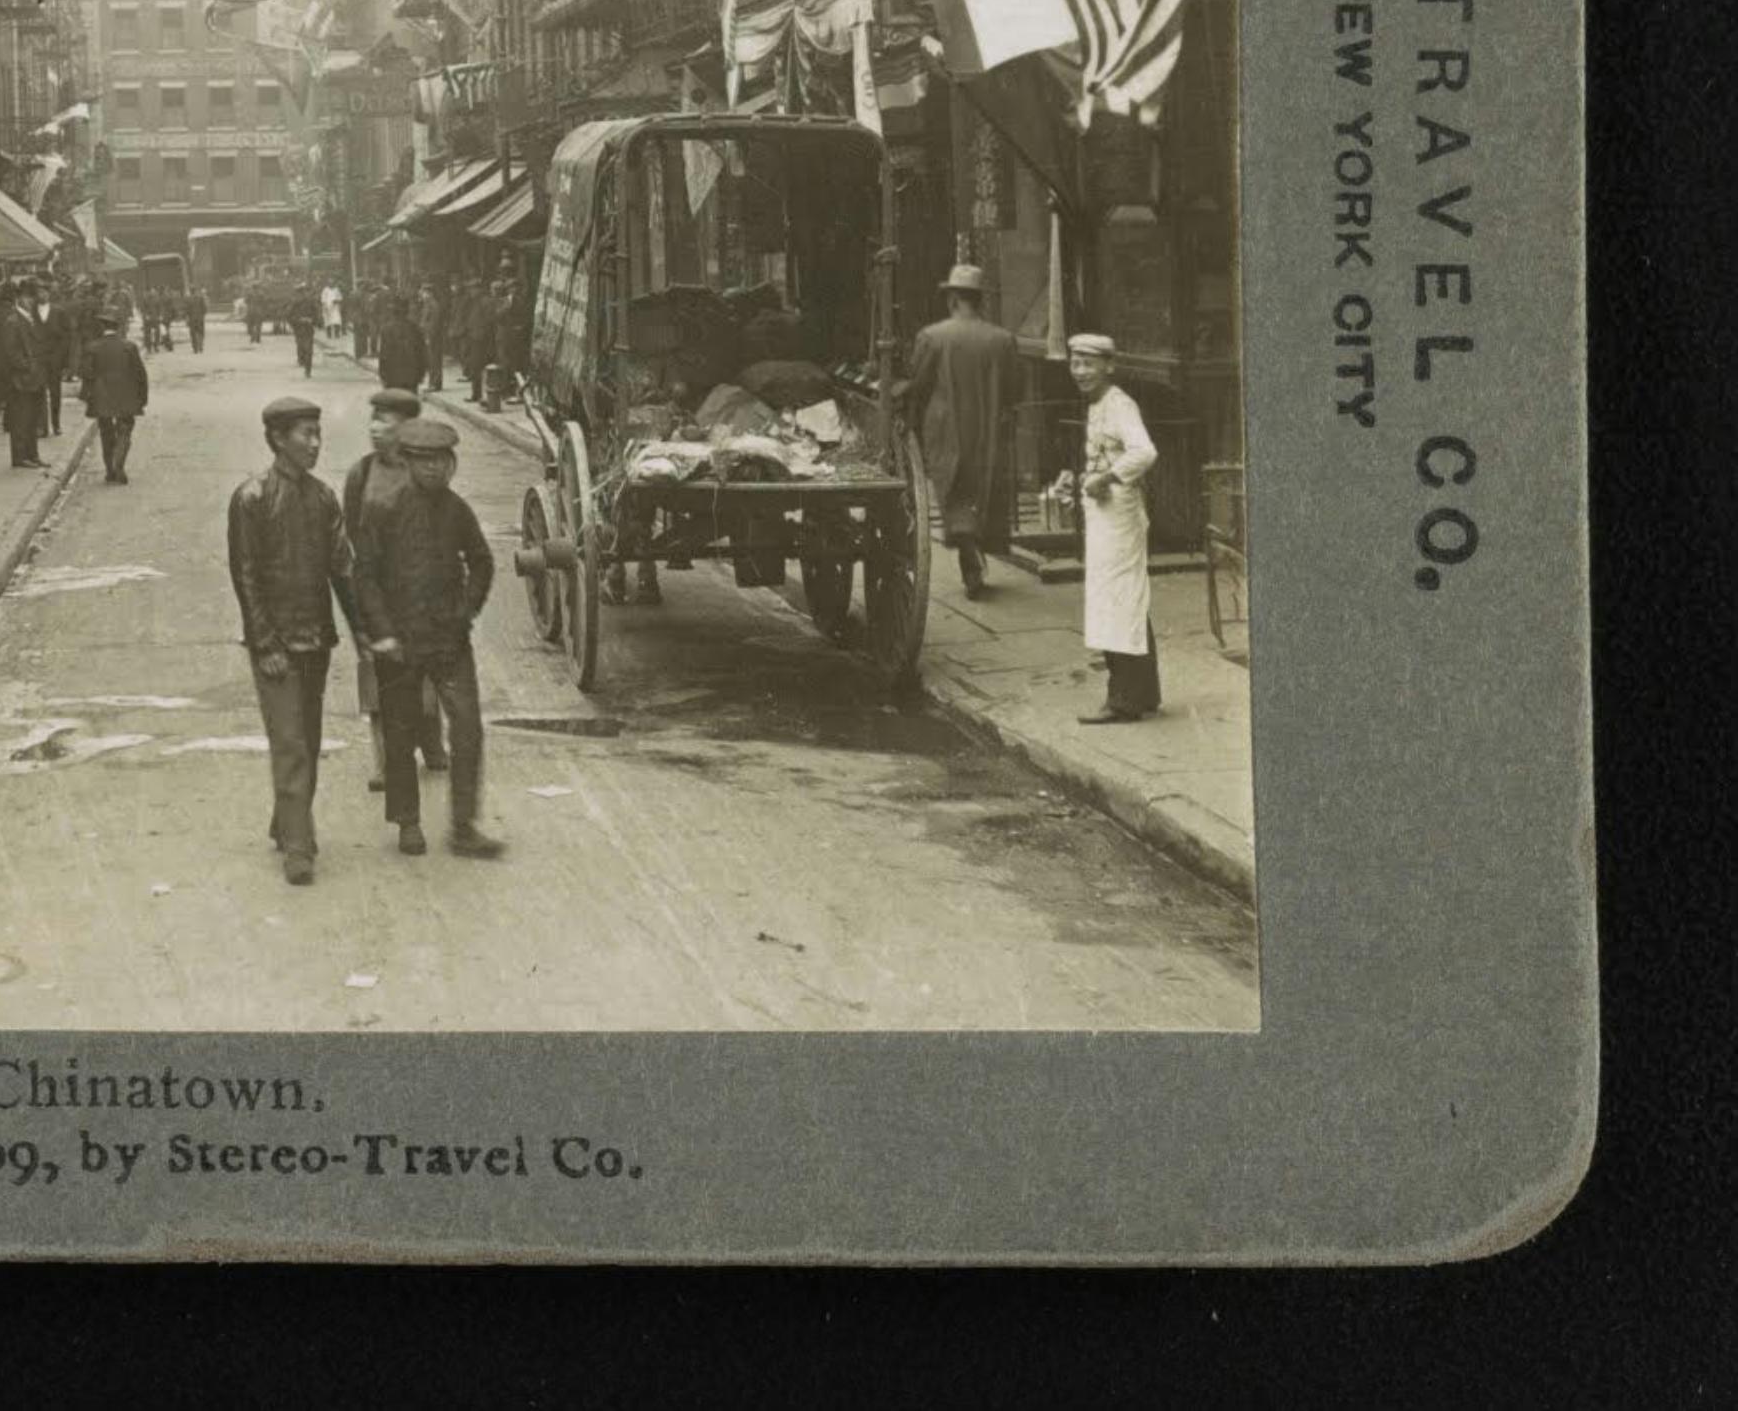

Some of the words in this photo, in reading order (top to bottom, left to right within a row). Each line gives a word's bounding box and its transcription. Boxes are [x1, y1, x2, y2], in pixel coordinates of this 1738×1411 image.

[1335, 112, 1373, 266] YORK
[1334, 295, 1375, 427] CITY
[1414, 436, 1479, 591] CO.
[79, 1129, 145, 1185] by
[168, 1133, 528, 1177] Stereo-Travel
[551, 1136, 643, 1180] Co.
